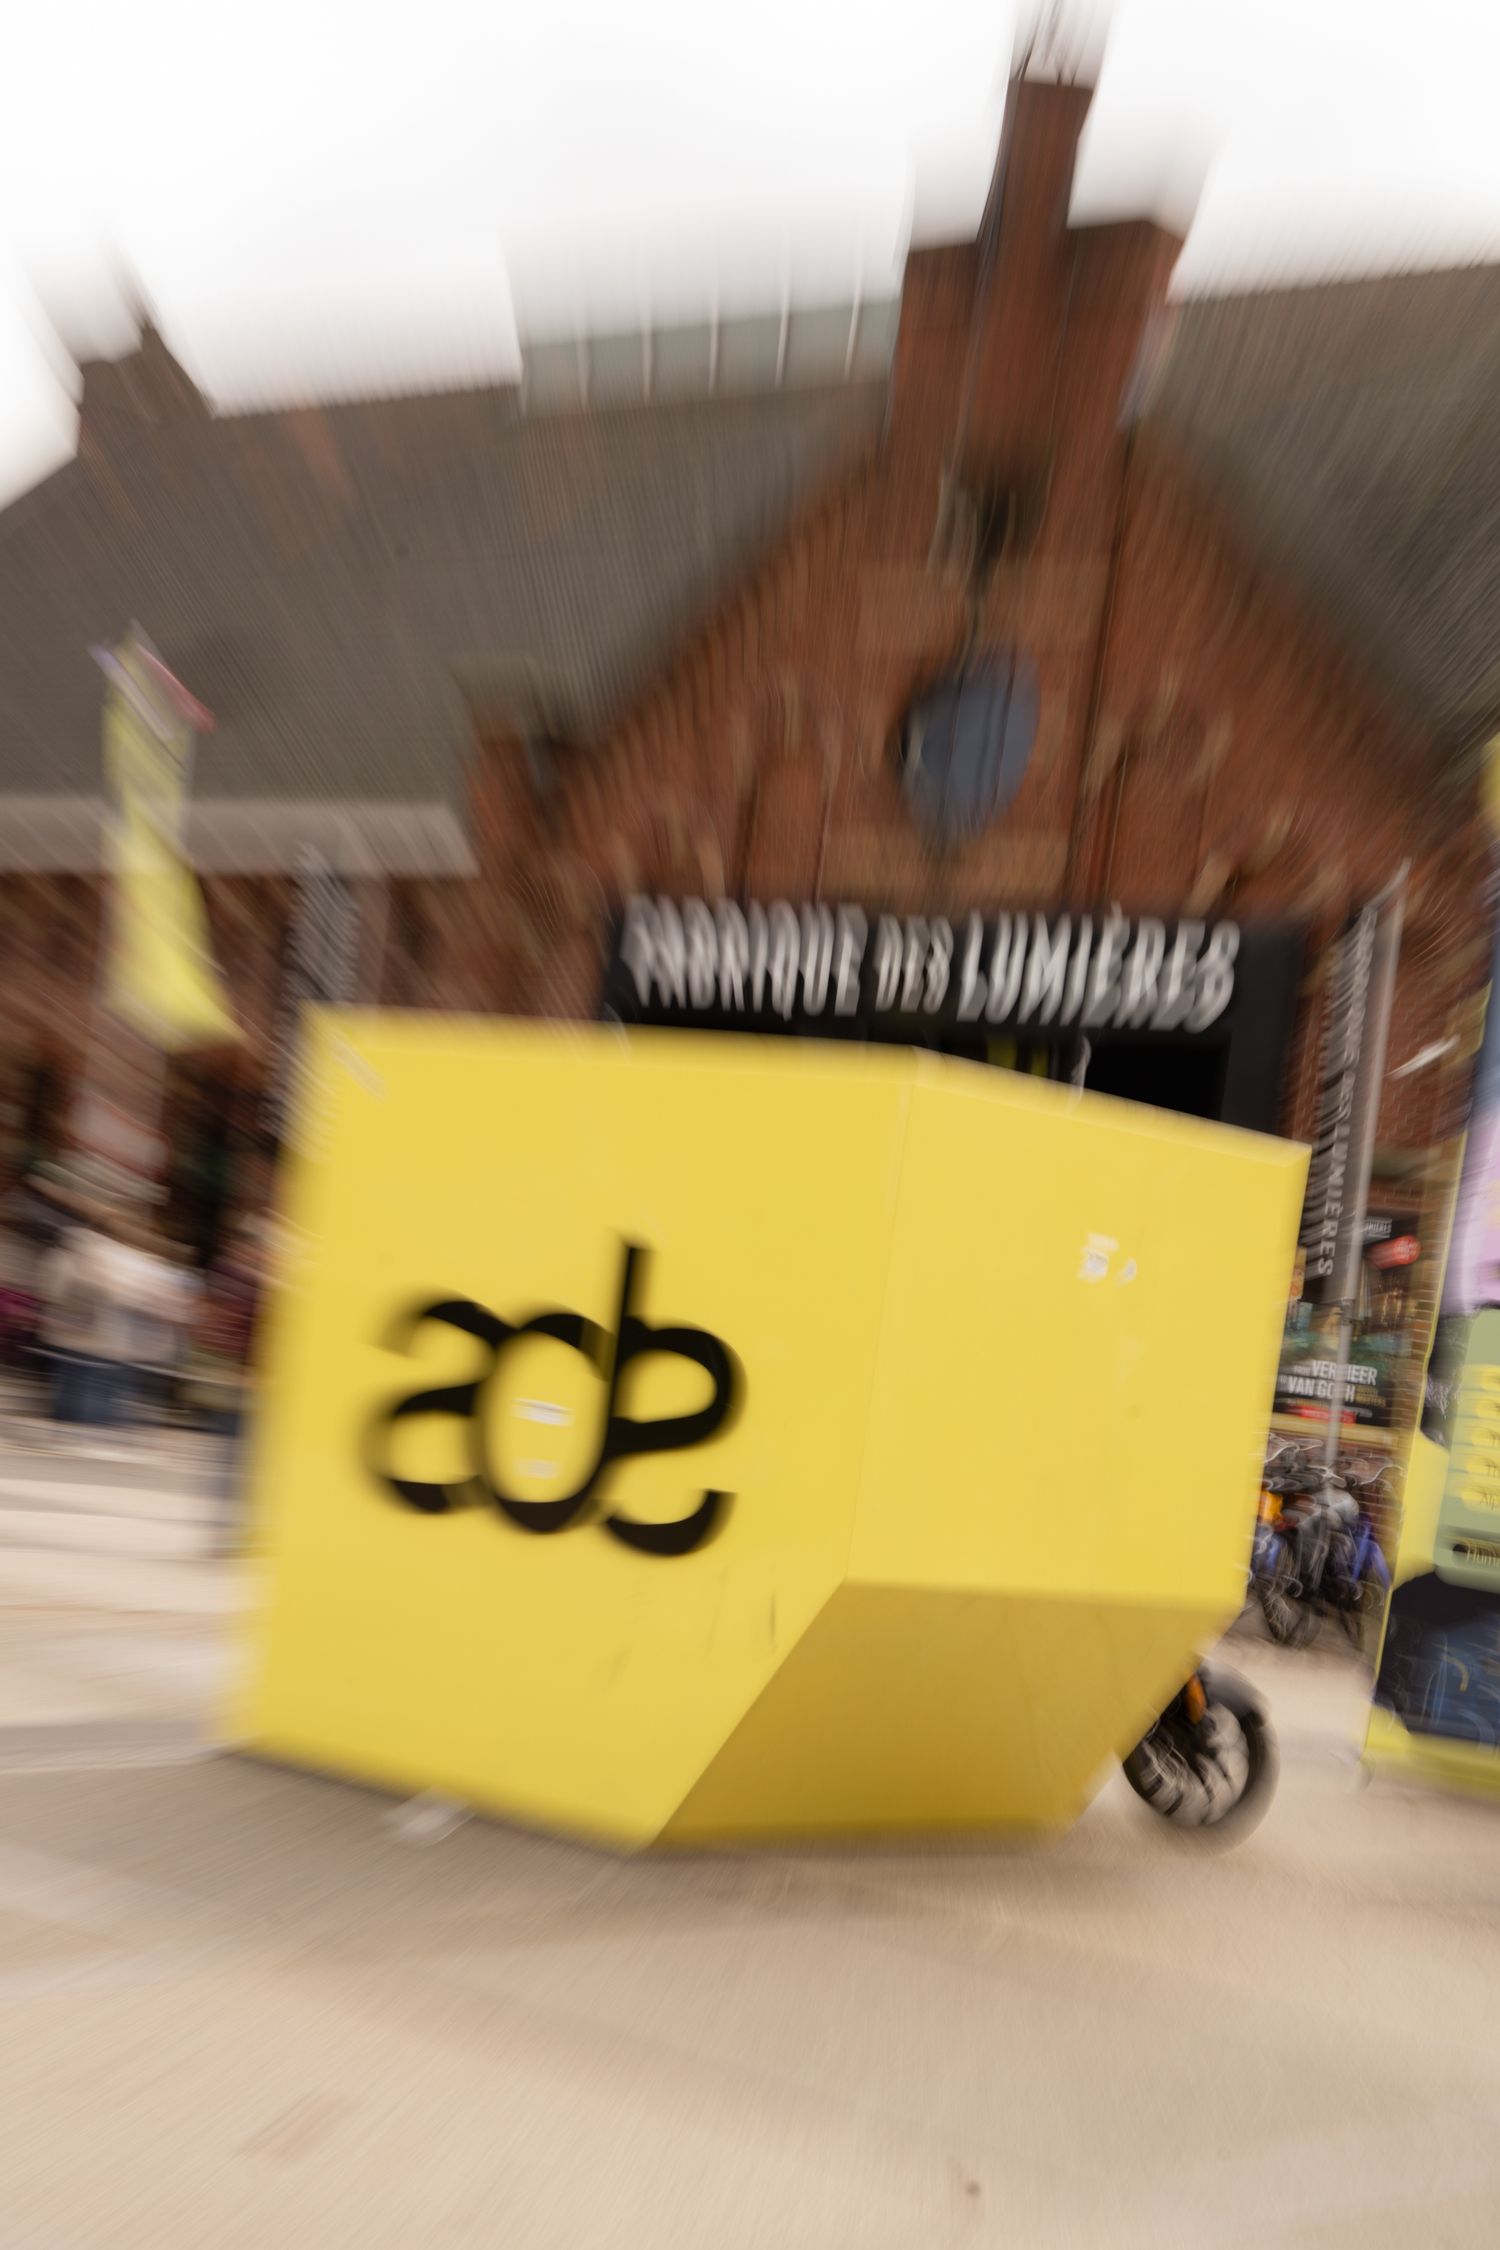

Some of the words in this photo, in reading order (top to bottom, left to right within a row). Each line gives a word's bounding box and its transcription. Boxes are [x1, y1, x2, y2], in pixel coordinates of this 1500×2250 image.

[876, 914, 953, 1013] DES
[1288, 1376, 1315, 1397] VAN
[1317, 1380, 1356, 1403] GOH
